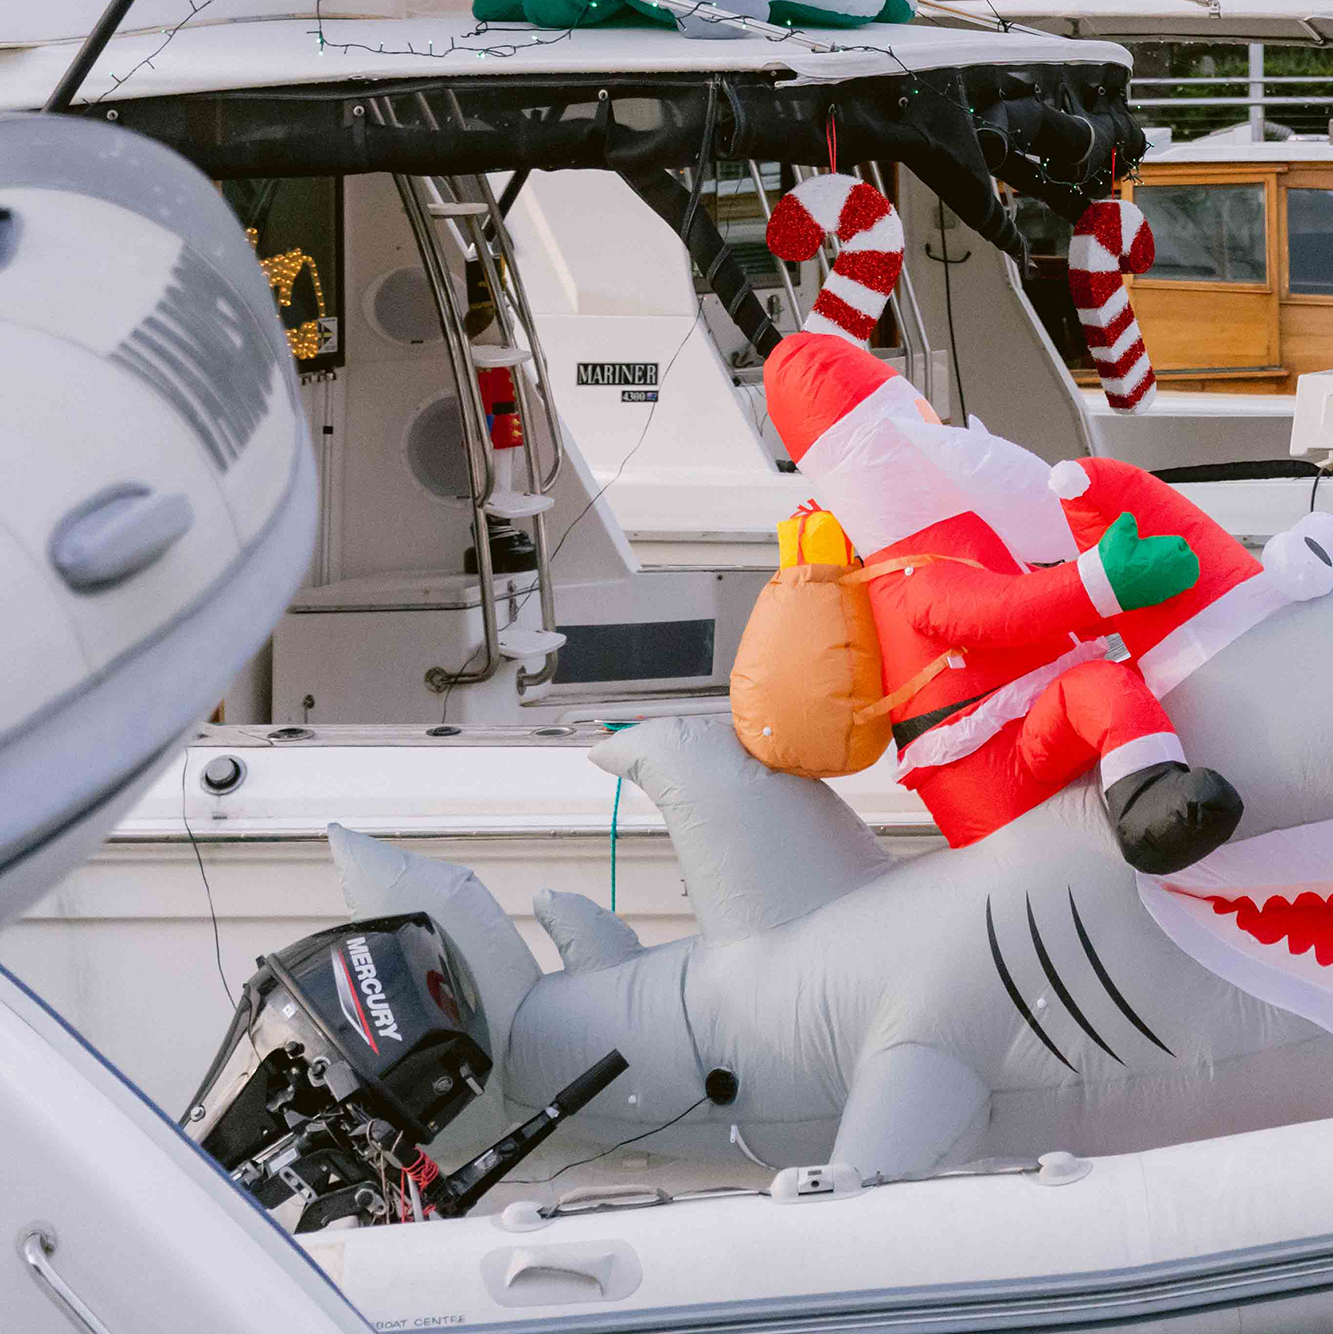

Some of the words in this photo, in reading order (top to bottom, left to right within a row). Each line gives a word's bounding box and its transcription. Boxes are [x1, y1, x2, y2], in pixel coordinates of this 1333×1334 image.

[578, 364, 657, 385] MARINER
[346, 936, 403, 1042] MERCURY
[413, 1314, 467, 1327] CENTRE
